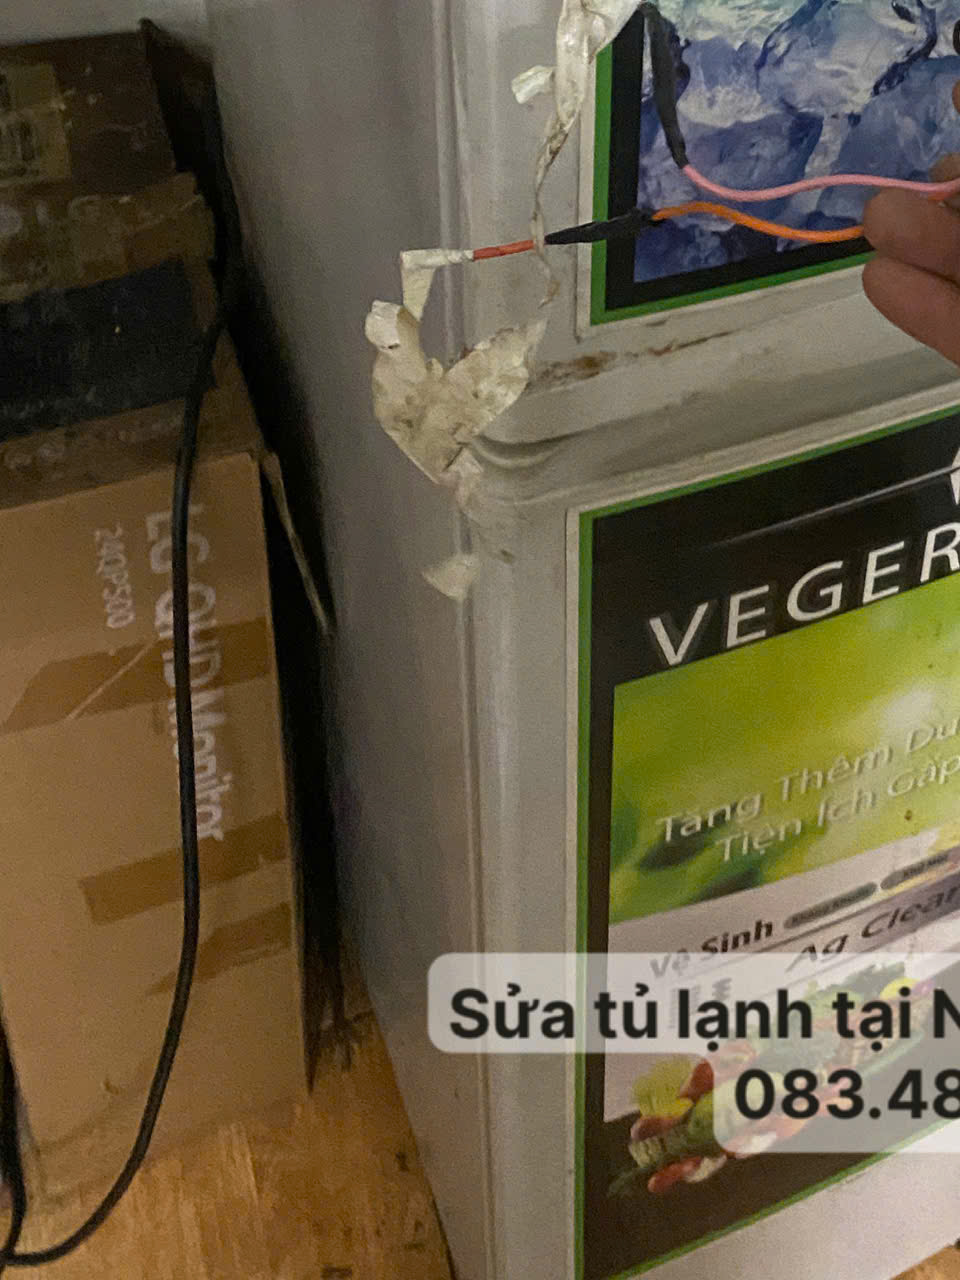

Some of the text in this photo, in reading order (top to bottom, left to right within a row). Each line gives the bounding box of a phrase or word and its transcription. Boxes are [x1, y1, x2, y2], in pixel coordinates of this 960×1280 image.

[778, 744, 893, 803] Thêm
[716, 817, 803, 863] Tiện
[702, 919, 773, 957] Sinh
